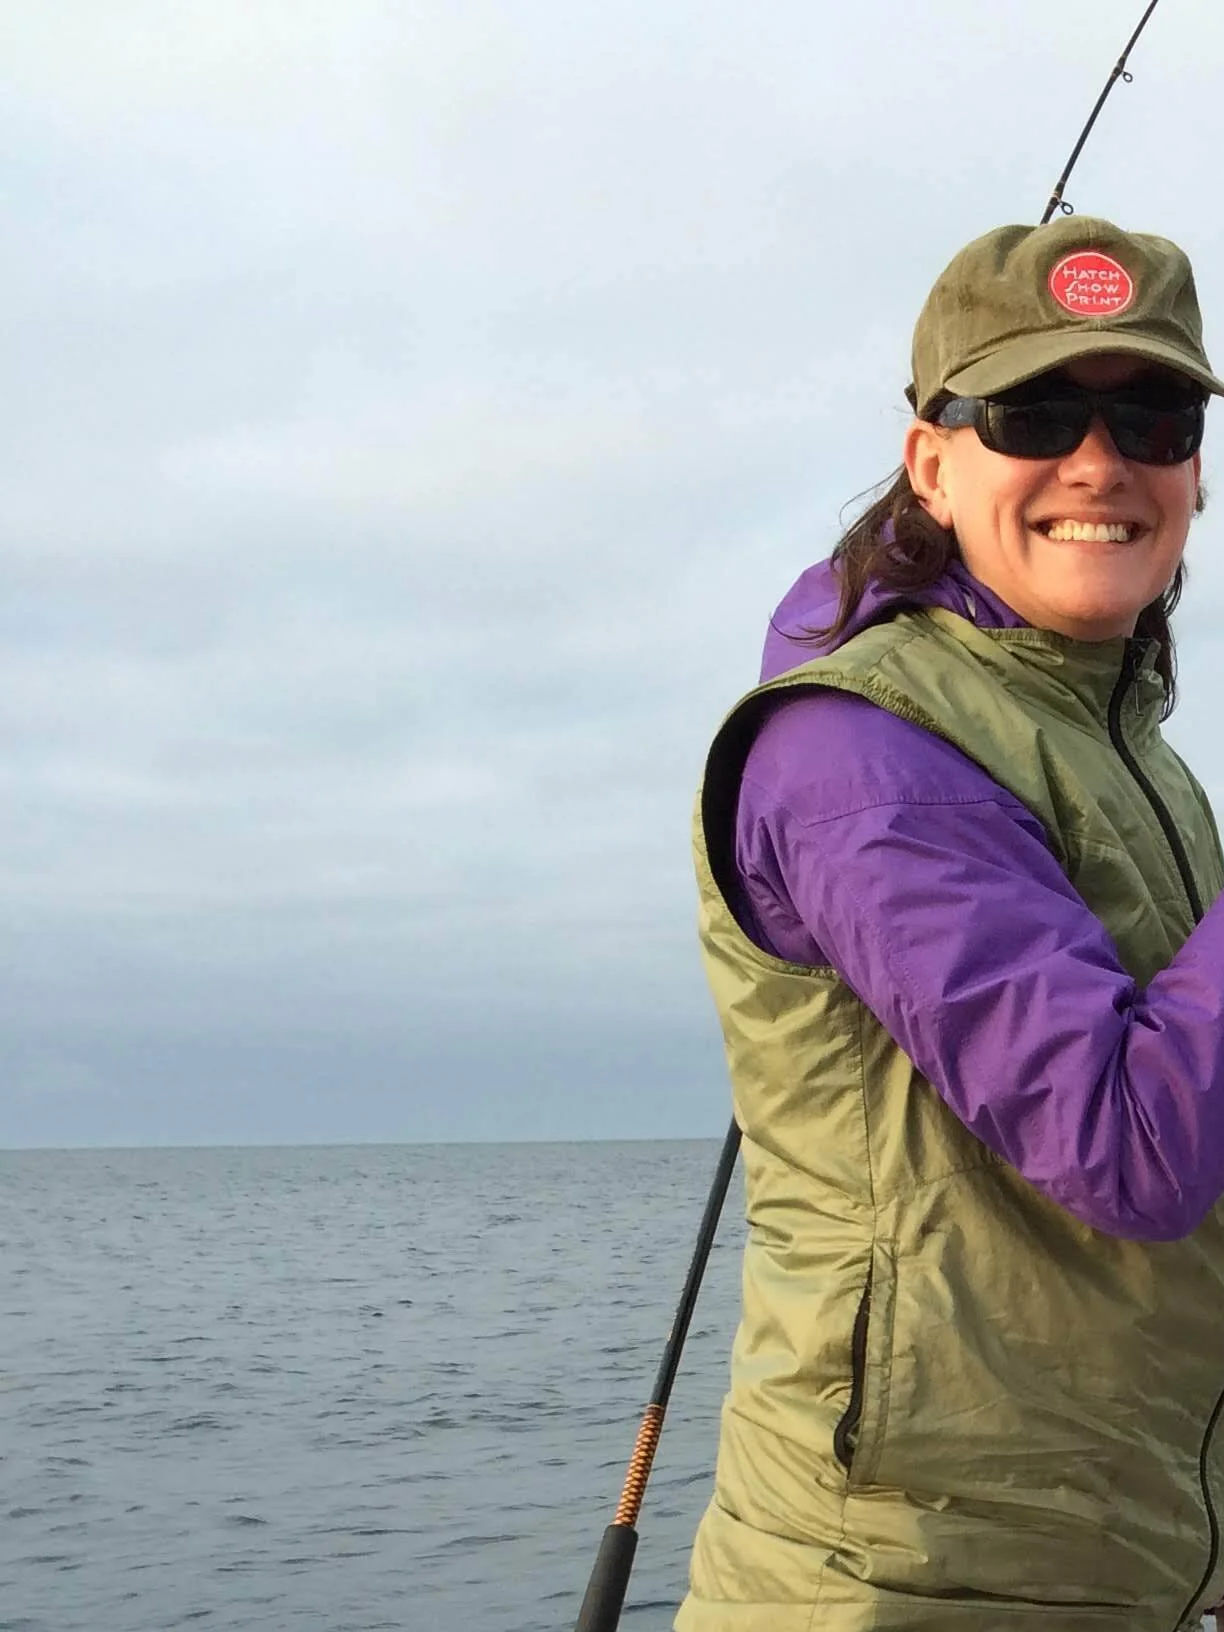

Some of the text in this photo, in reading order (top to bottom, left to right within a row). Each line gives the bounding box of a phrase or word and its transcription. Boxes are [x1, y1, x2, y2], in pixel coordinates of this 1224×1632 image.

[1062, 266, 1120, 281] HATCH
[1064, 280, 1119, 294] SHOW
[1065, 292, 1121, 306] PRINT
